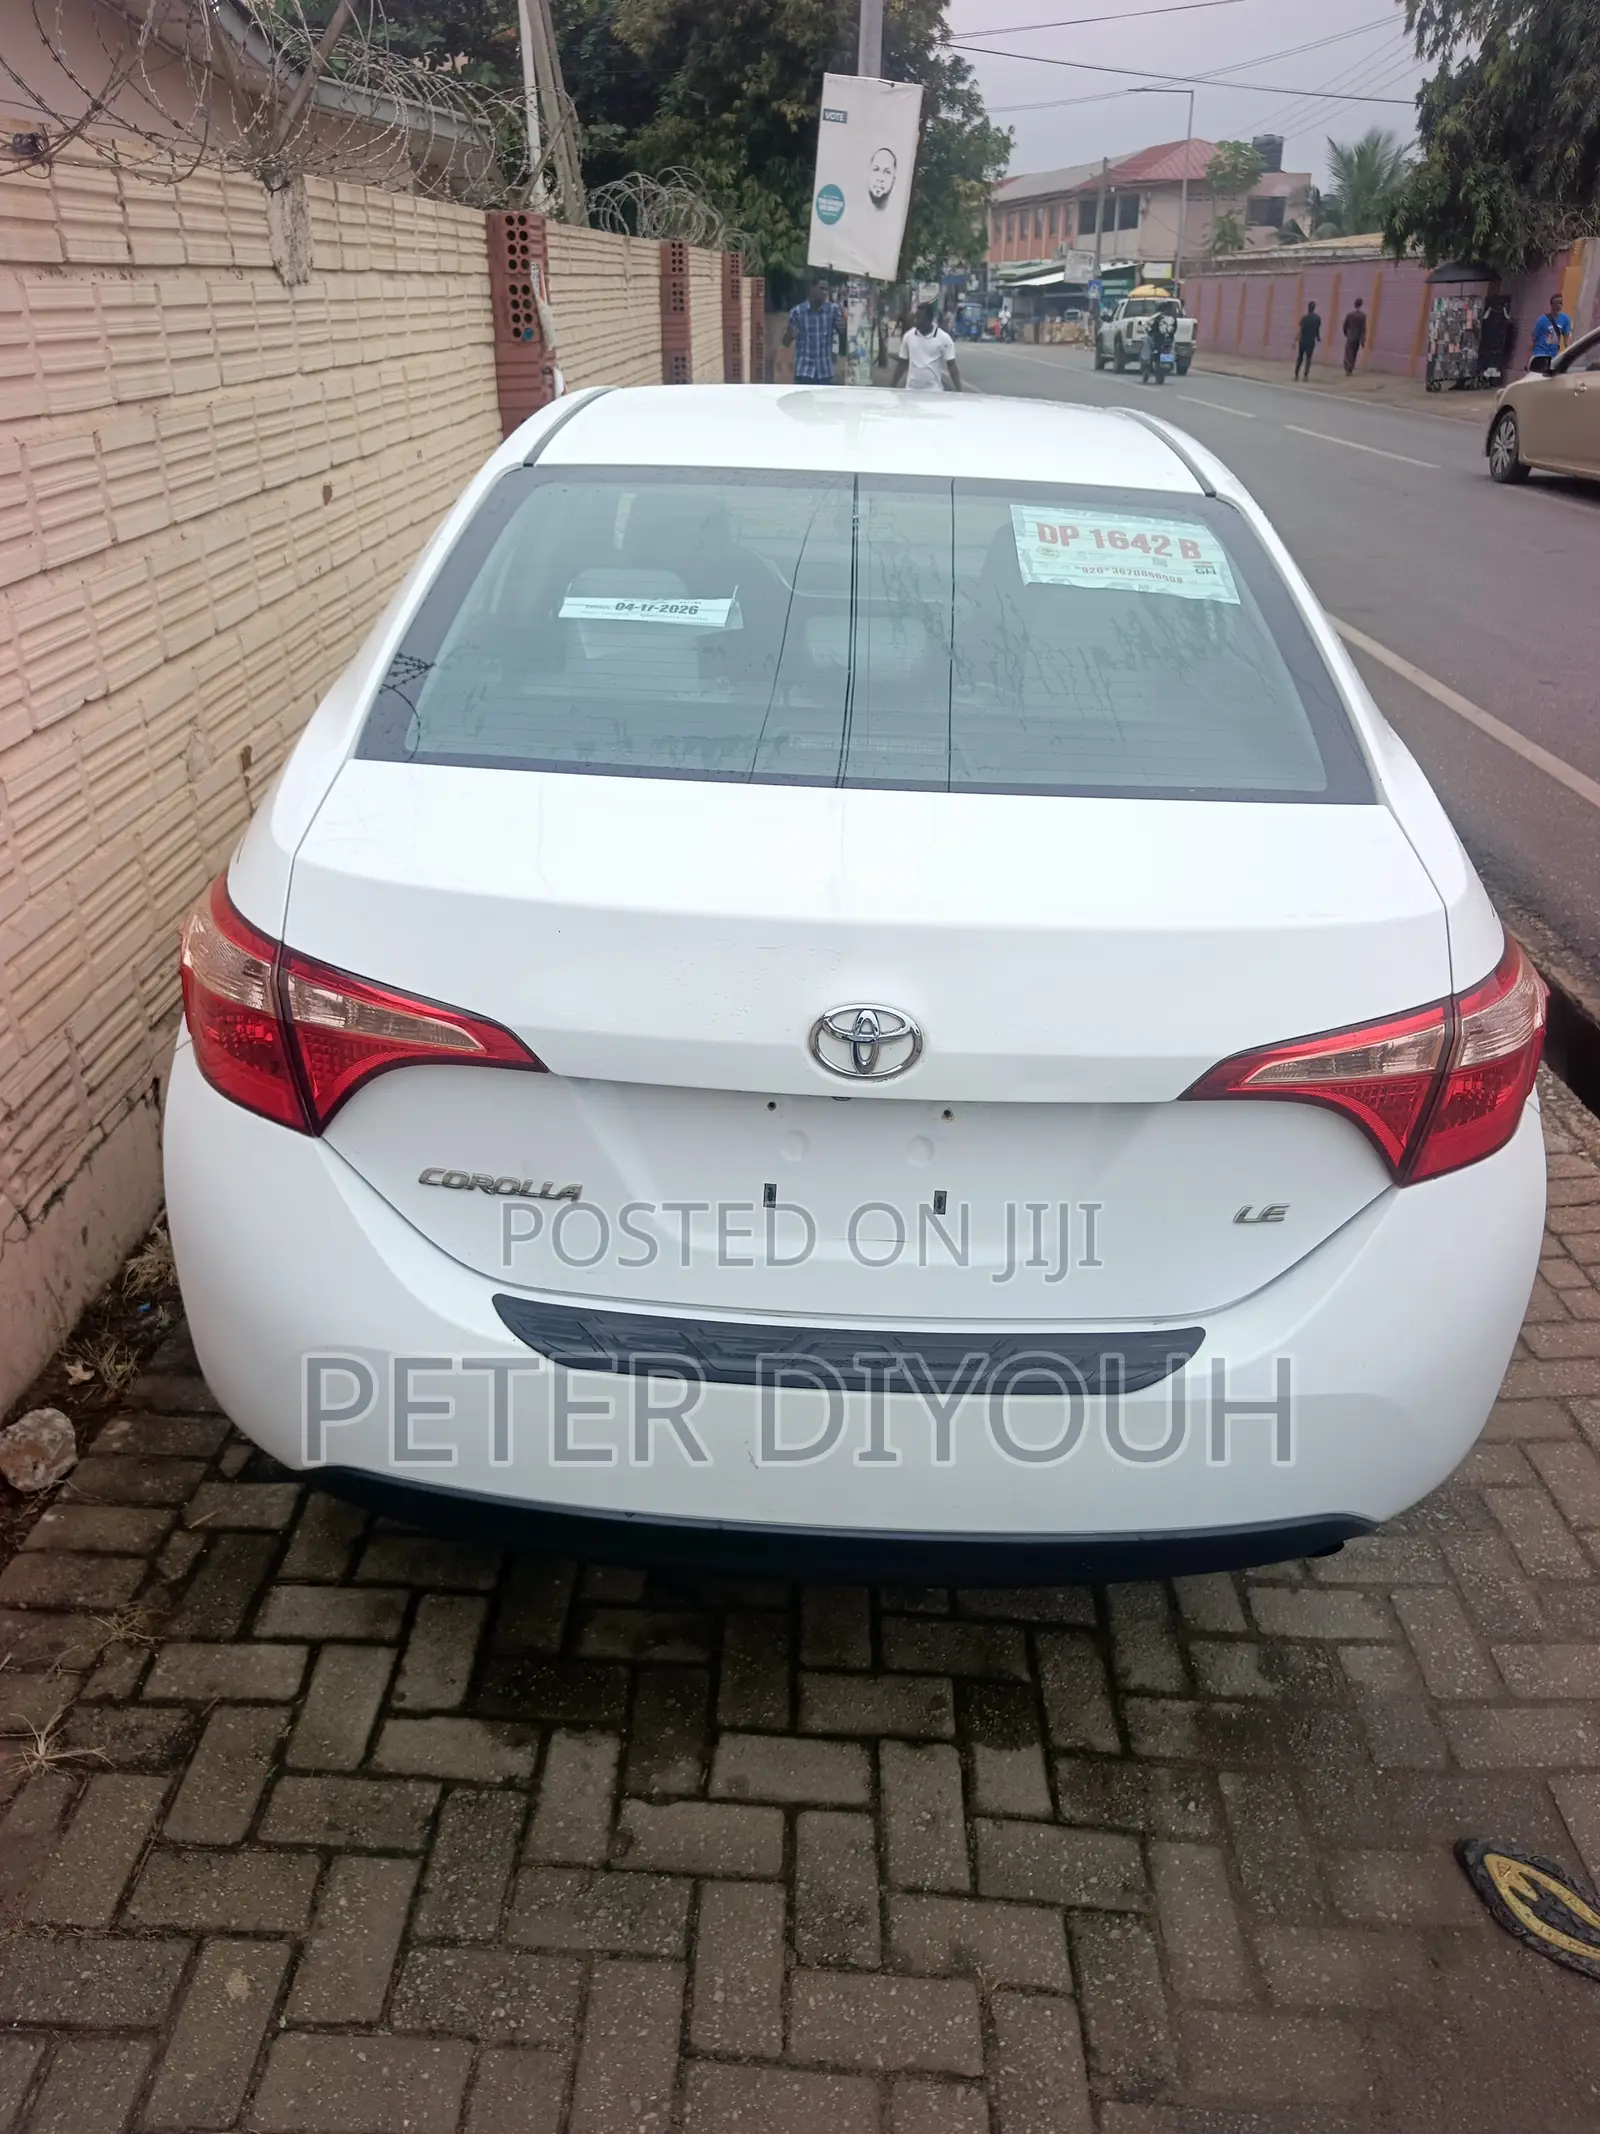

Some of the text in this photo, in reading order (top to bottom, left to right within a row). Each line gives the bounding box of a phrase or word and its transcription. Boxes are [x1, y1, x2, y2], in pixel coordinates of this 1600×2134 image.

[825, 111, 845, 121] VOTE
[1037, 523, 1079, 546] DP
[1089, 529, 1172, 557] 1642
[1180, 538, 1202, 560] B
[615, 602, 699, 615] 04-17-2026
[418, 1167, 583, 1202] COROLLA
[1232, 1202, 1290, 1223] LE
